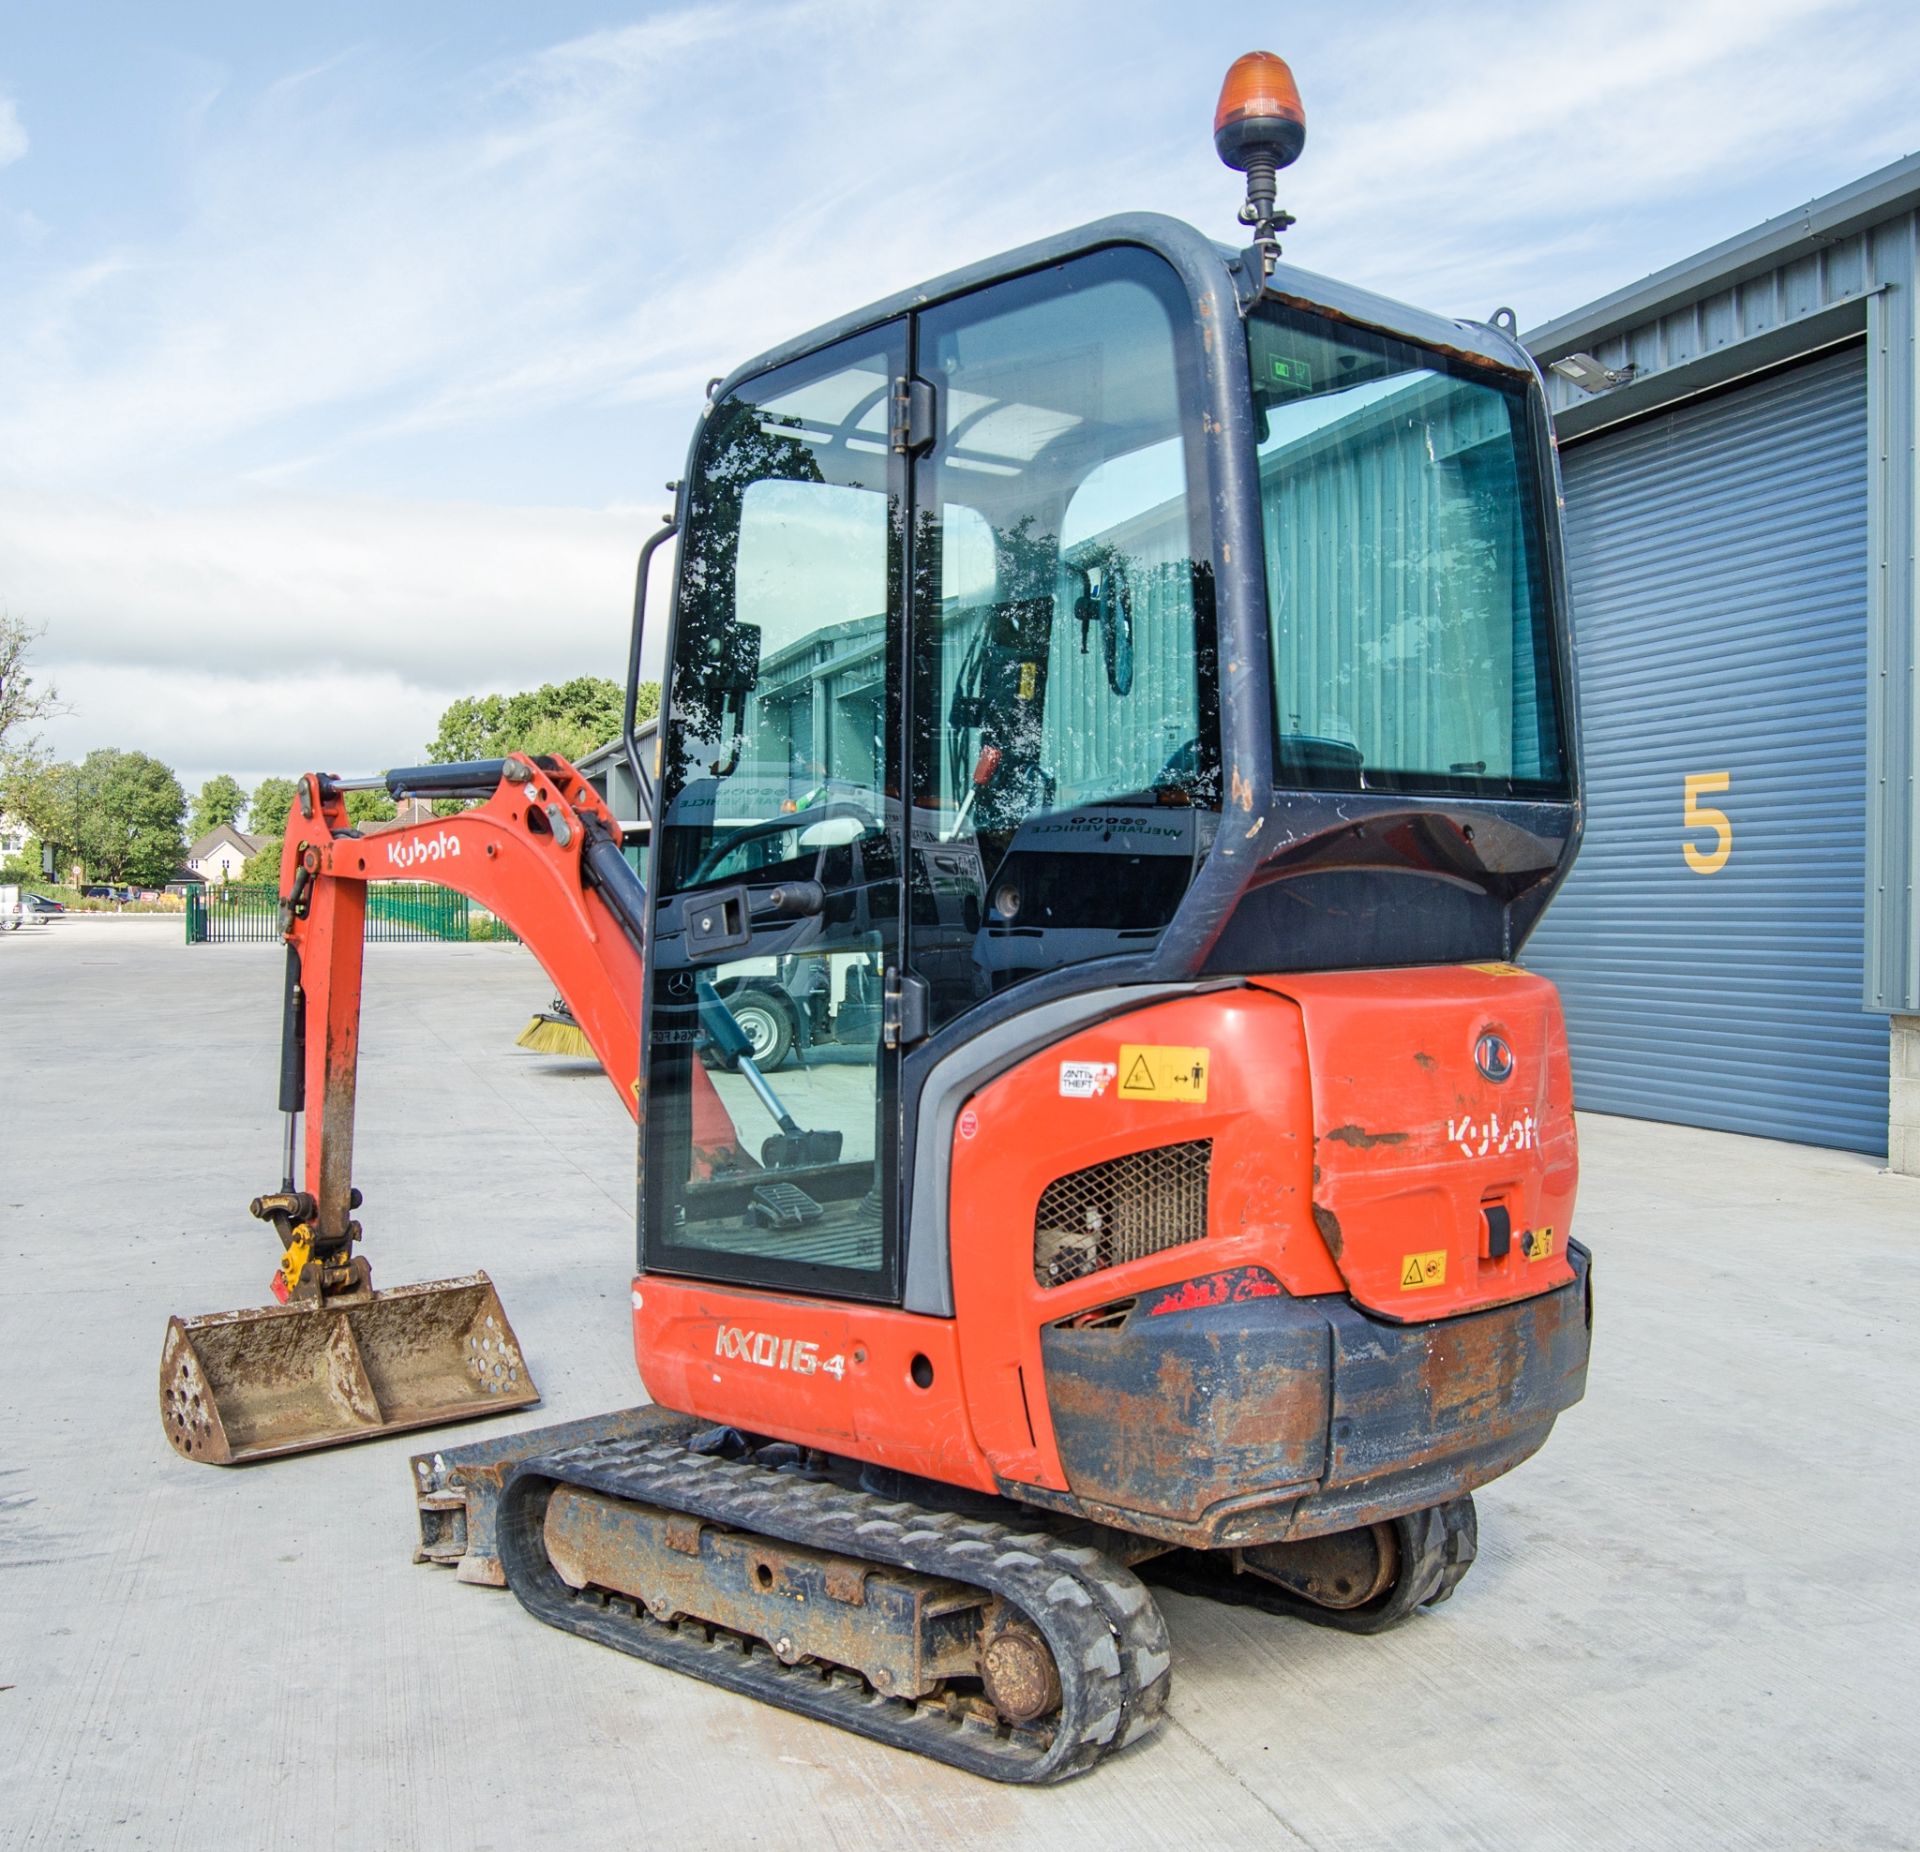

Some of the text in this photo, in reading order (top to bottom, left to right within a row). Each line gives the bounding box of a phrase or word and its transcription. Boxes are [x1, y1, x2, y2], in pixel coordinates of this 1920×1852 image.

[1682, 771, 1733, 875] 5
[387, 830, 461, 868] Kubota
[1063, 1079, 1093, 1089] THEFT
[714, 1324, 846, 1381] KX016-4
